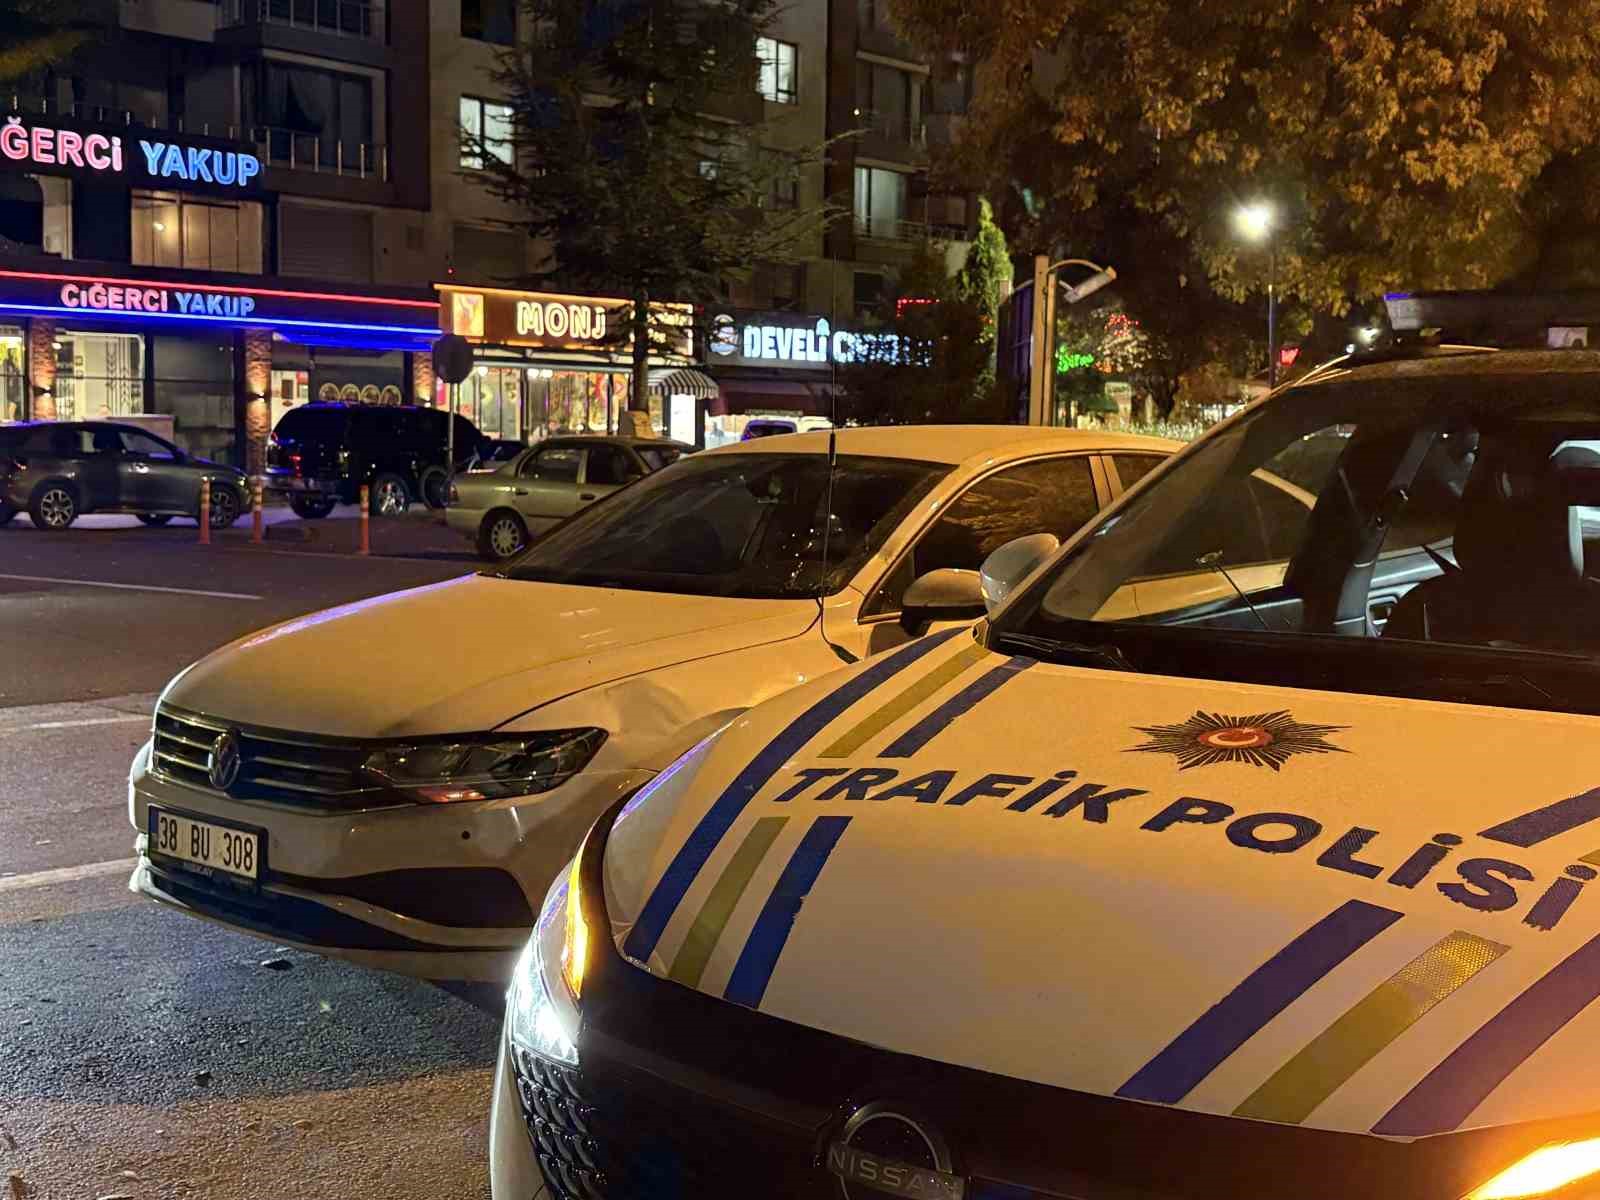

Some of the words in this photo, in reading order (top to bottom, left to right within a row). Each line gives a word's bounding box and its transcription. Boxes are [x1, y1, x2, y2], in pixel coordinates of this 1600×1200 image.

[139, 140, 260, 186] YAKUP
[175, 291, 256, 317] YAKUP
[159, 817, 178, 851] 38
[191, 825, 210, 860] BU
[223, 832, 253, 871] 308
[774, 769, 1150, 824] TRAFİK
[1142, 797, 1598, 932] POLİSİ
